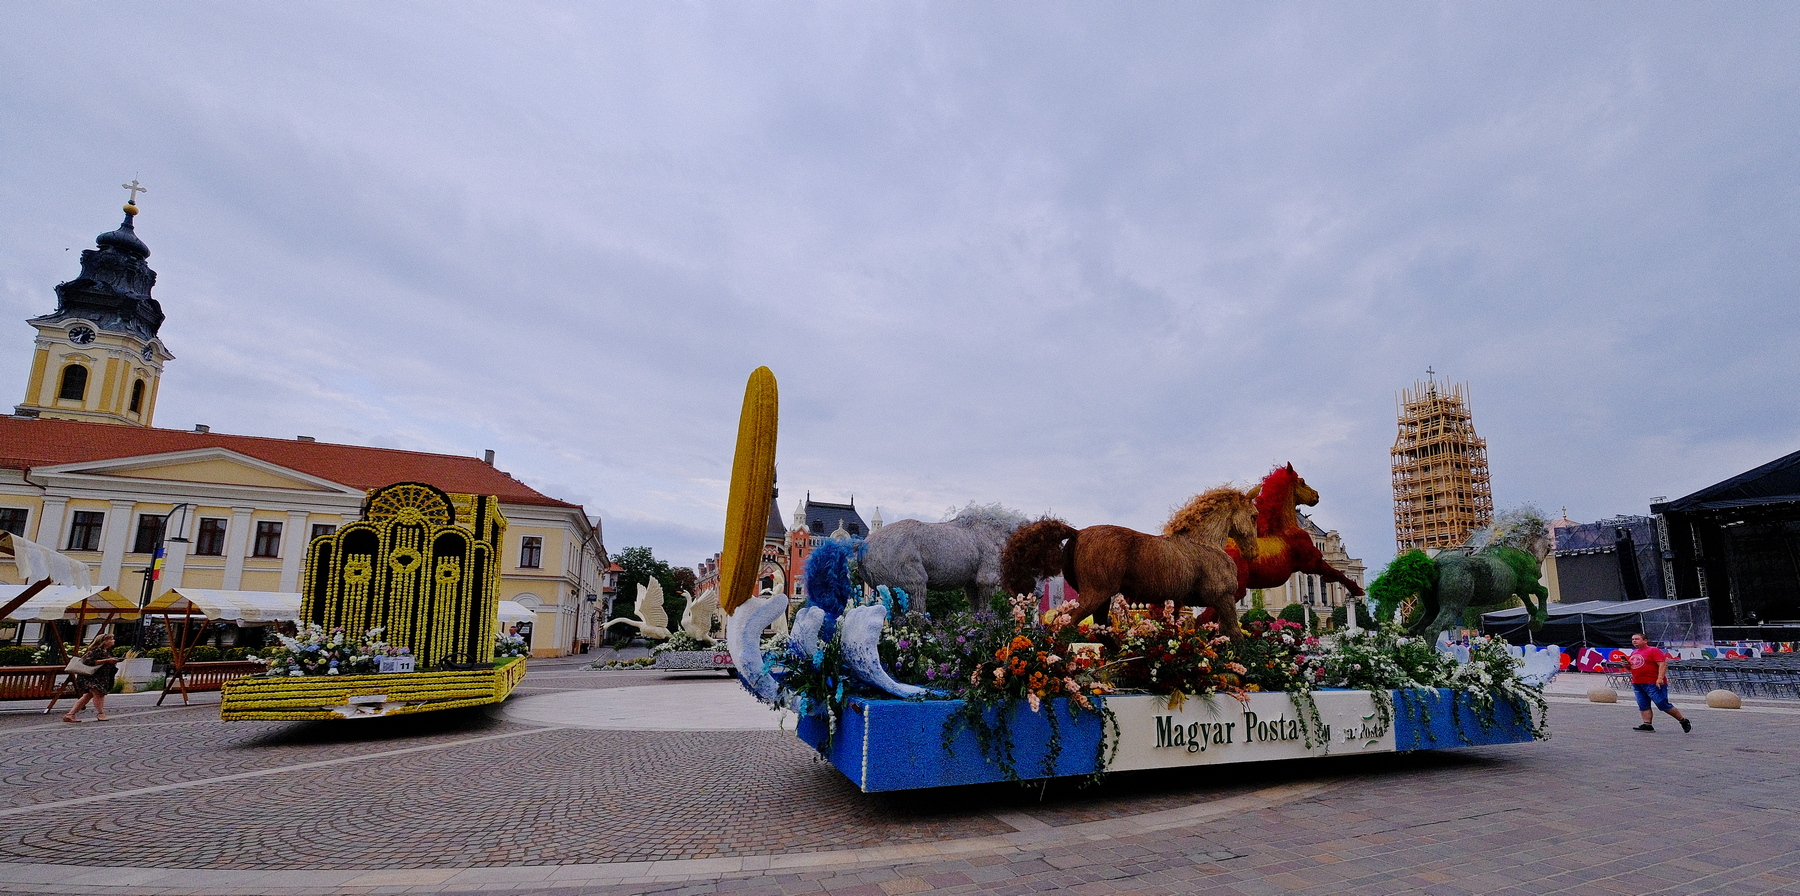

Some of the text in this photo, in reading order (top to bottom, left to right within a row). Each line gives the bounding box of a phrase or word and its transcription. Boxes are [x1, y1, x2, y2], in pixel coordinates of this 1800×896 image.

[1153, 711, 1300, 753] Magyar Posta
[1358, 722, 1385, 740] Posta
